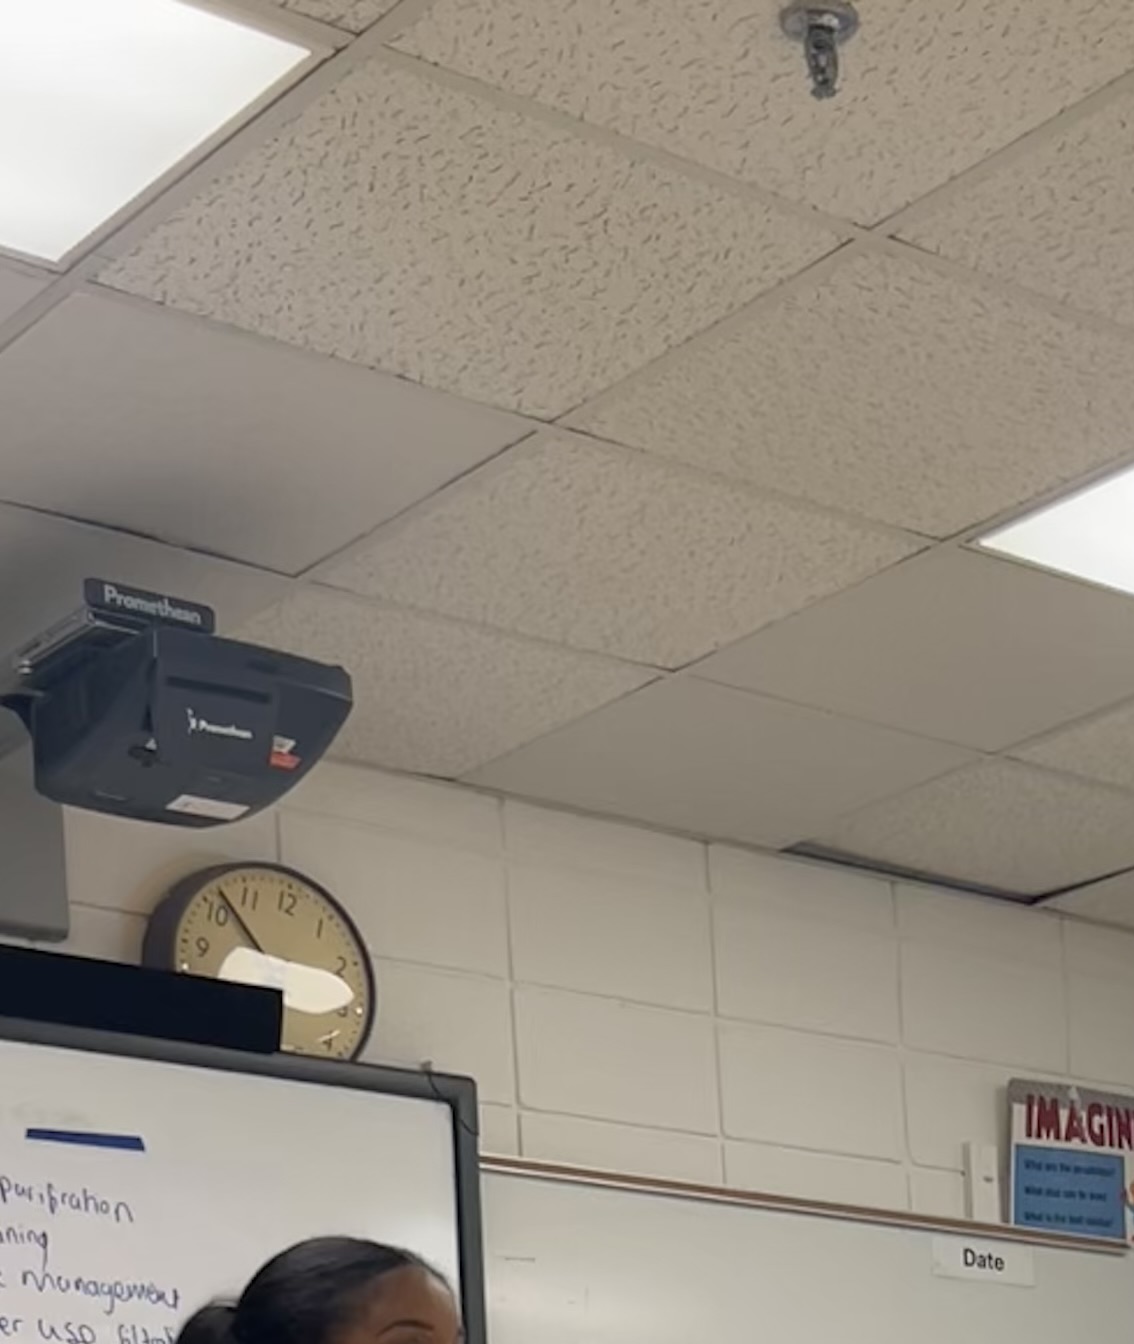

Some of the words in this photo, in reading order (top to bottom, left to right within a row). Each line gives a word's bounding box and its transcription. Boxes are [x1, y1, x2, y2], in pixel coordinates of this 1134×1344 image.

[103, 584, 202, 626] Promethean
[241, 886, 259, 911] 11
[278, 890, 298, 916] 12
[206, 900, 229, 927] 10
[316, 918, 324, 939] 1
[196, 937, 210, 957] 9
[963, 1248, 1005, 1271] Date
